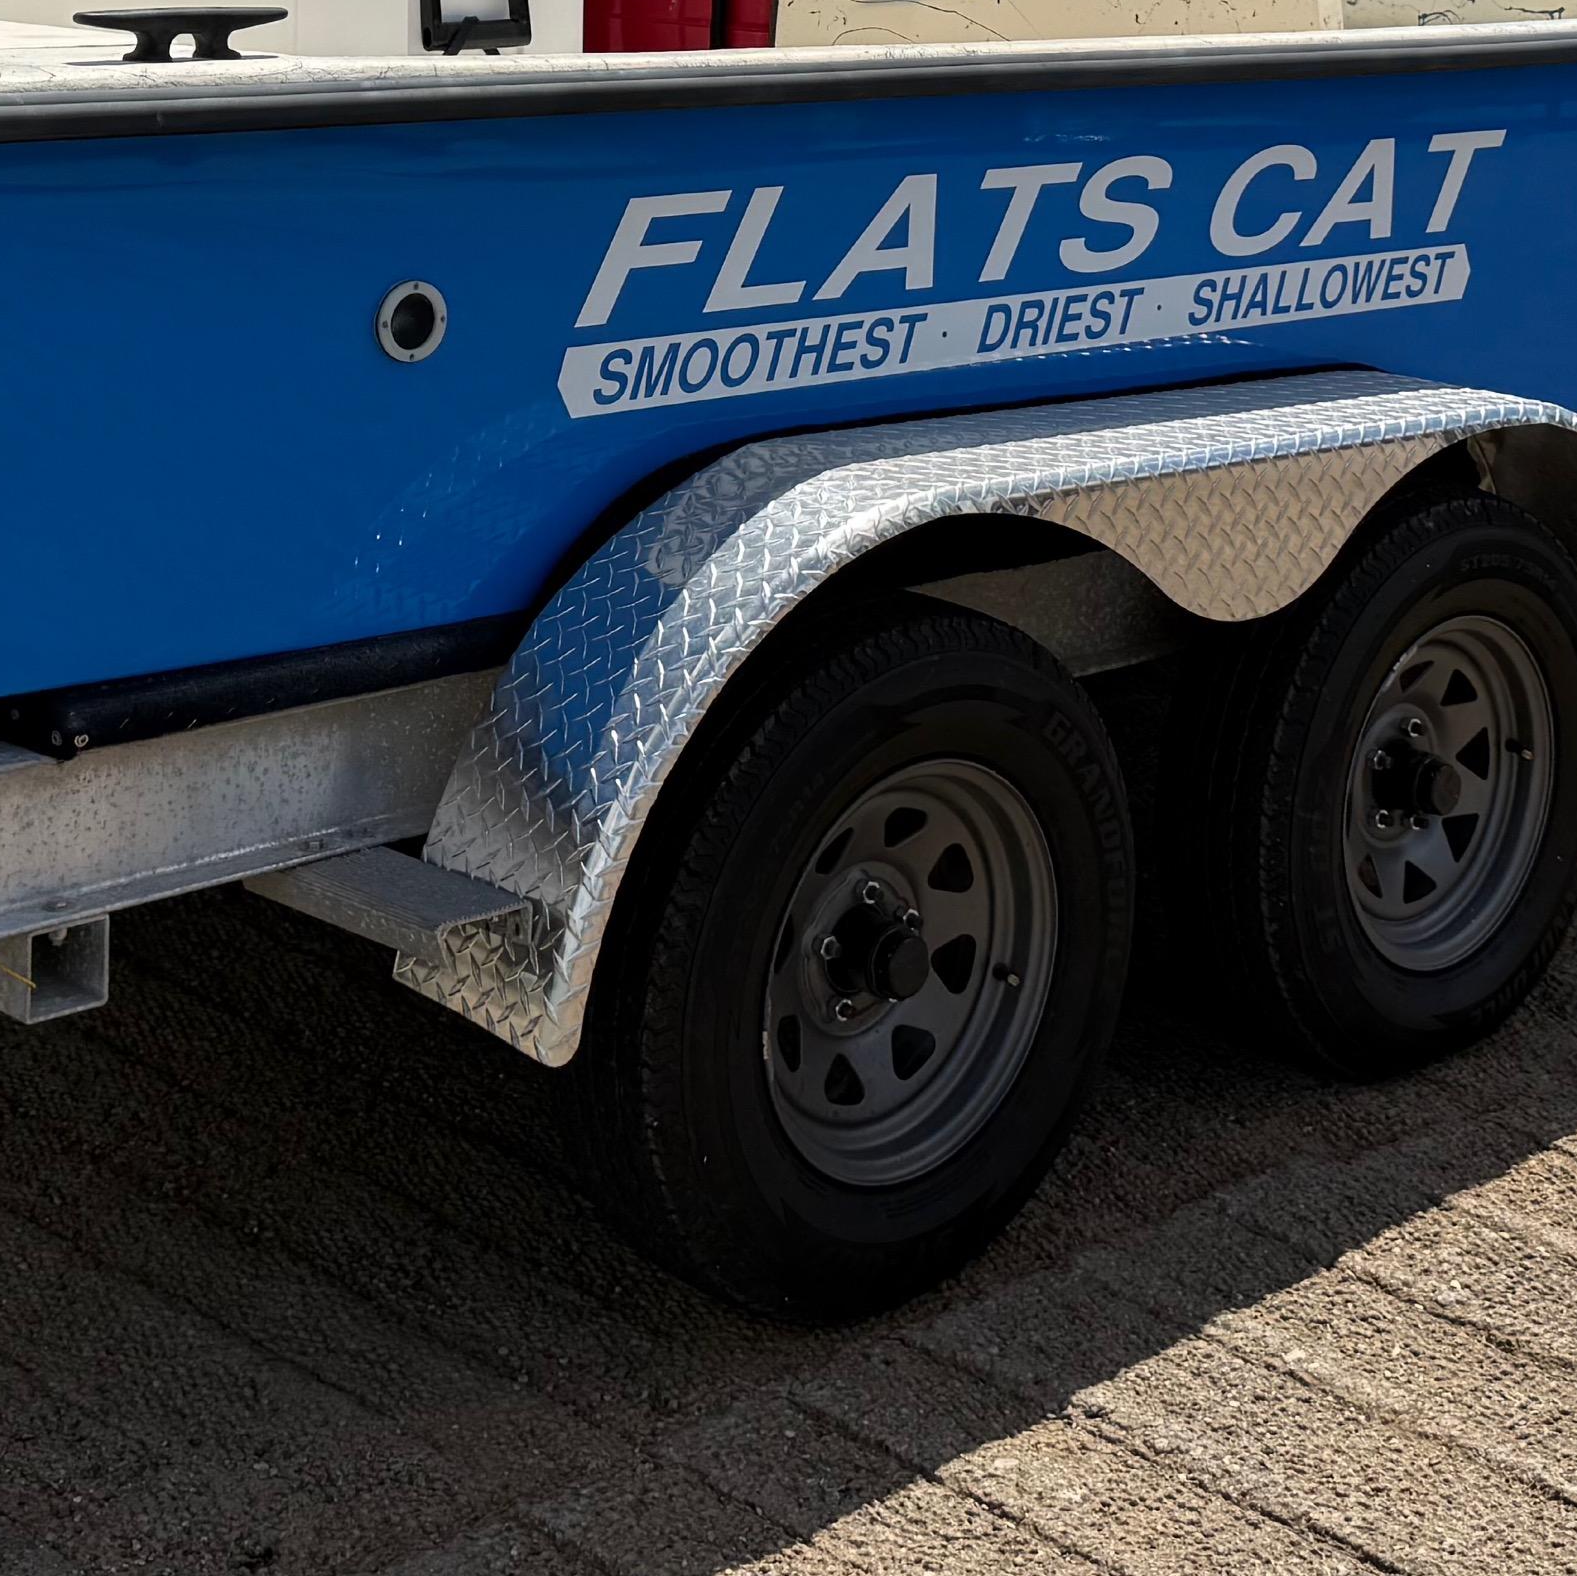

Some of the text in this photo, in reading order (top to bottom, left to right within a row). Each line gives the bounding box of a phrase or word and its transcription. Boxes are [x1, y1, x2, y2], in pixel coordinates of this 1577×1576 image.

[574, 130, 1506, 328] FLATS CAT
[593, 250, 1456, 406] SMOOTHEST DRIEST SHALLOWEST
